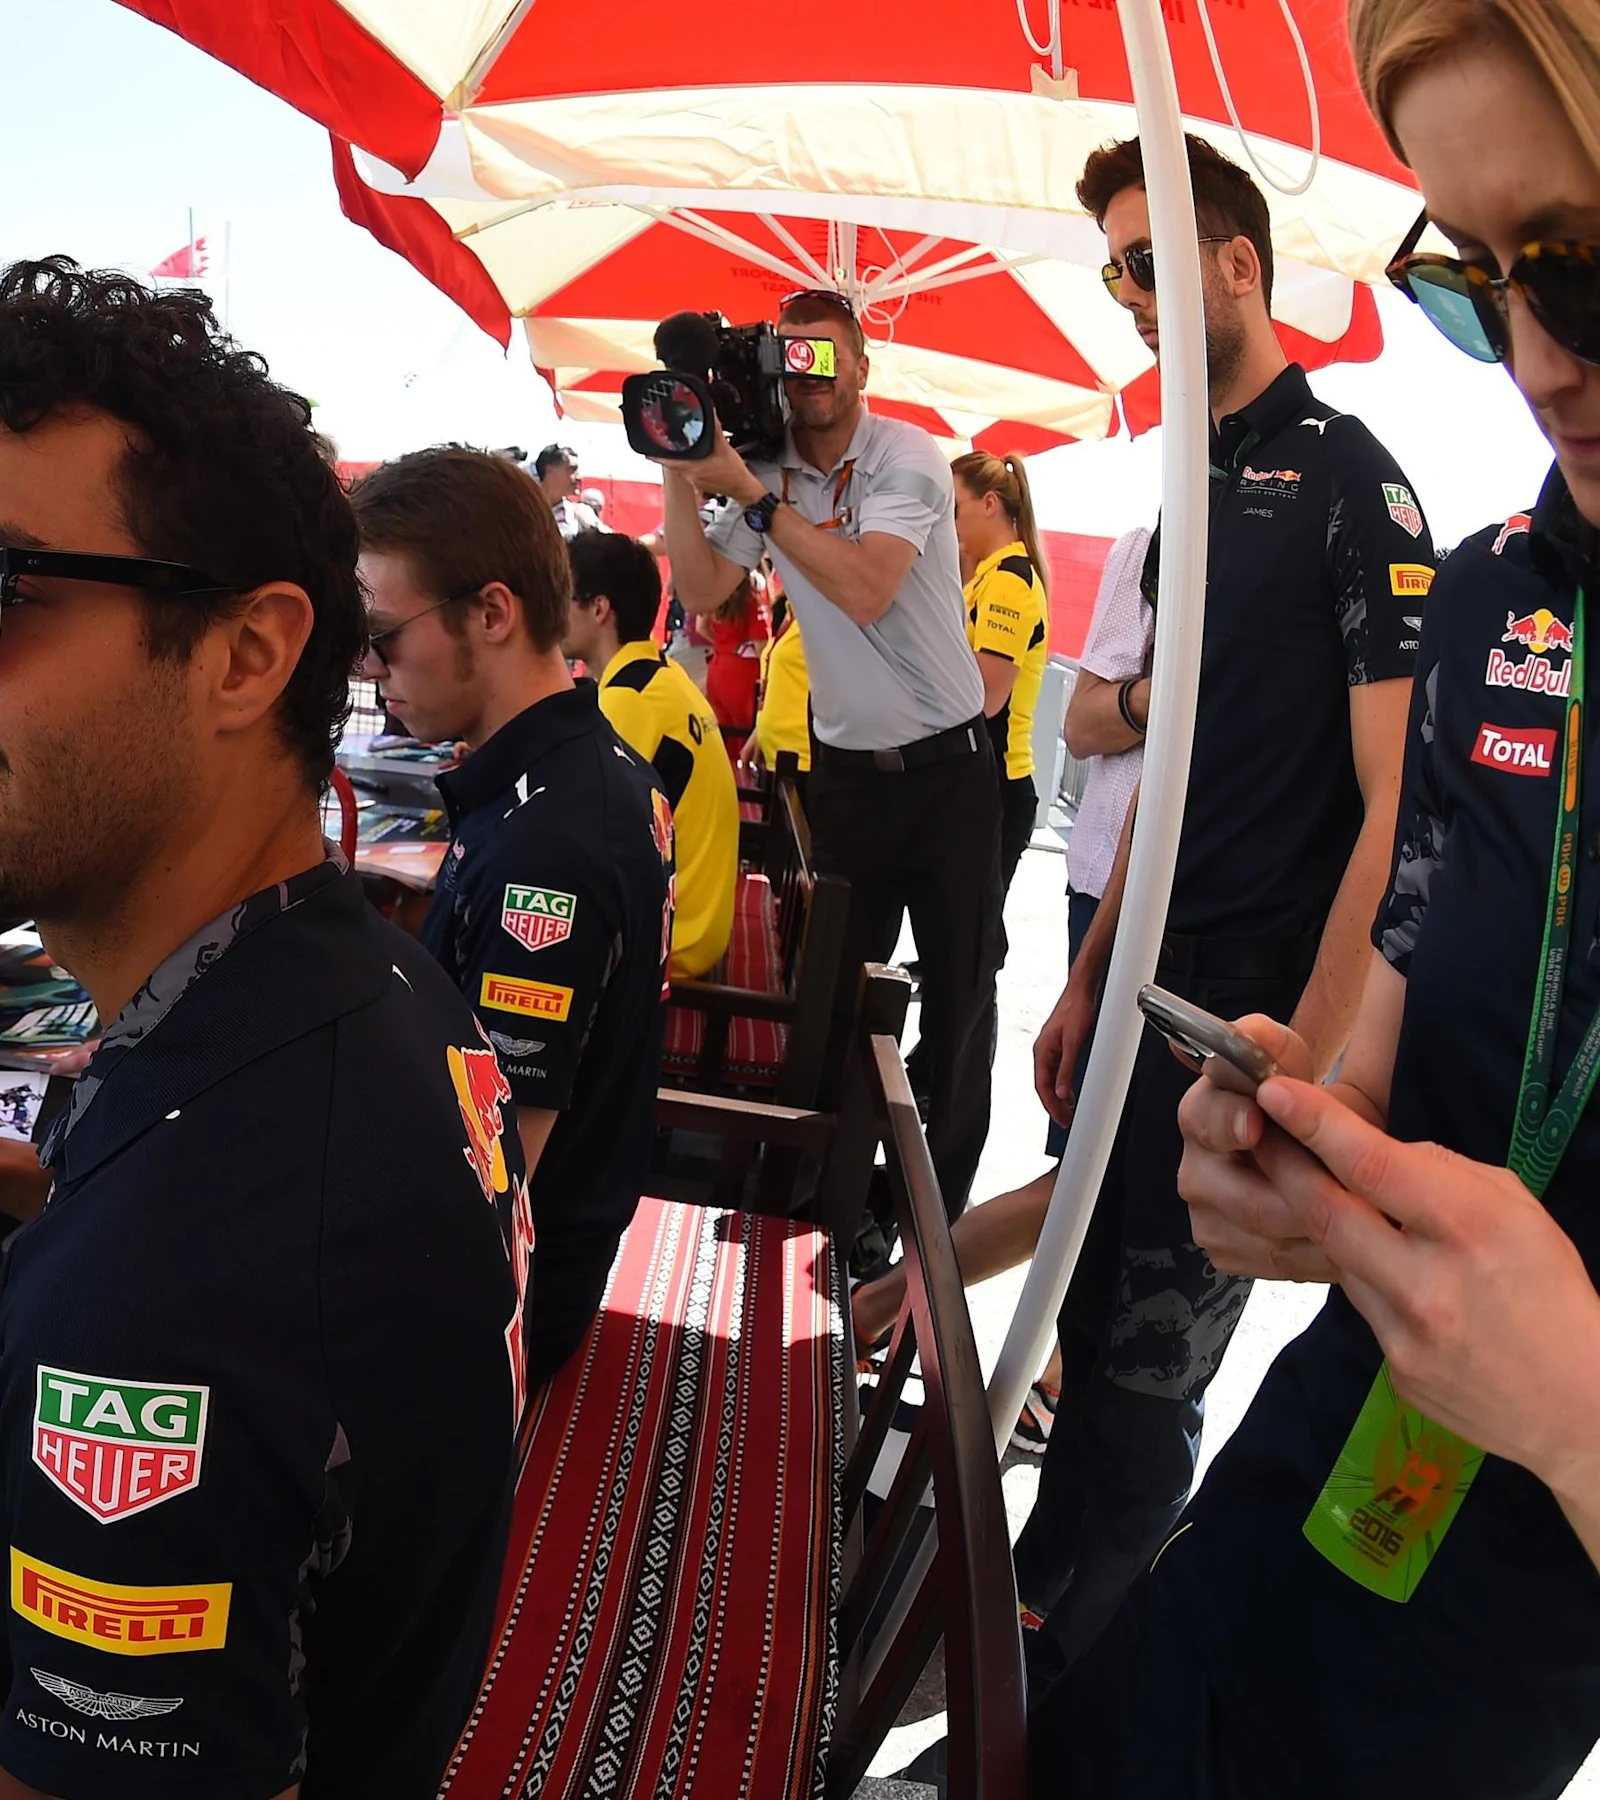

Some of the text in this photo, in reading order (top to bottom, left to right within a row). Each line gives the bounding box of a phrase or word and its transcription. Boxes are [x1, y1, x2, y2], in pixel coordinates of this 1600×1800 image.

[1243, 507, 1274, 518] JAMES
[1396, 570, 1434, 590] PIRE
[987, 619, 1016, 635] TOTAL
[989, 603, 1020, 620] PIRELLI
[1399, 640, 1419, 650] ASTO
[1485, 648, 1533, 691] Red
[1481, 728, 1550, 769] TOTAL
[511, 889, 569, 917] TAG
[506, 912, 567, 947] HEUER
[1546, 948, 1557, 982] WORLD
[488, 980, 564, 1013] PIRELLI
[1549, 964, 1562, 1011] FORMULA
[506, 1063, 547, 1079] MARTIN
[47, 1378, 189, 1439] TAG
[40, 1431, 190, 1510] HEUER
[1350, 1507, 1405, 1557] 2016
[22, 1565, 210, 1643] PIRELLI
[15, 1707, 201, 1758] ASTON MARTIN
